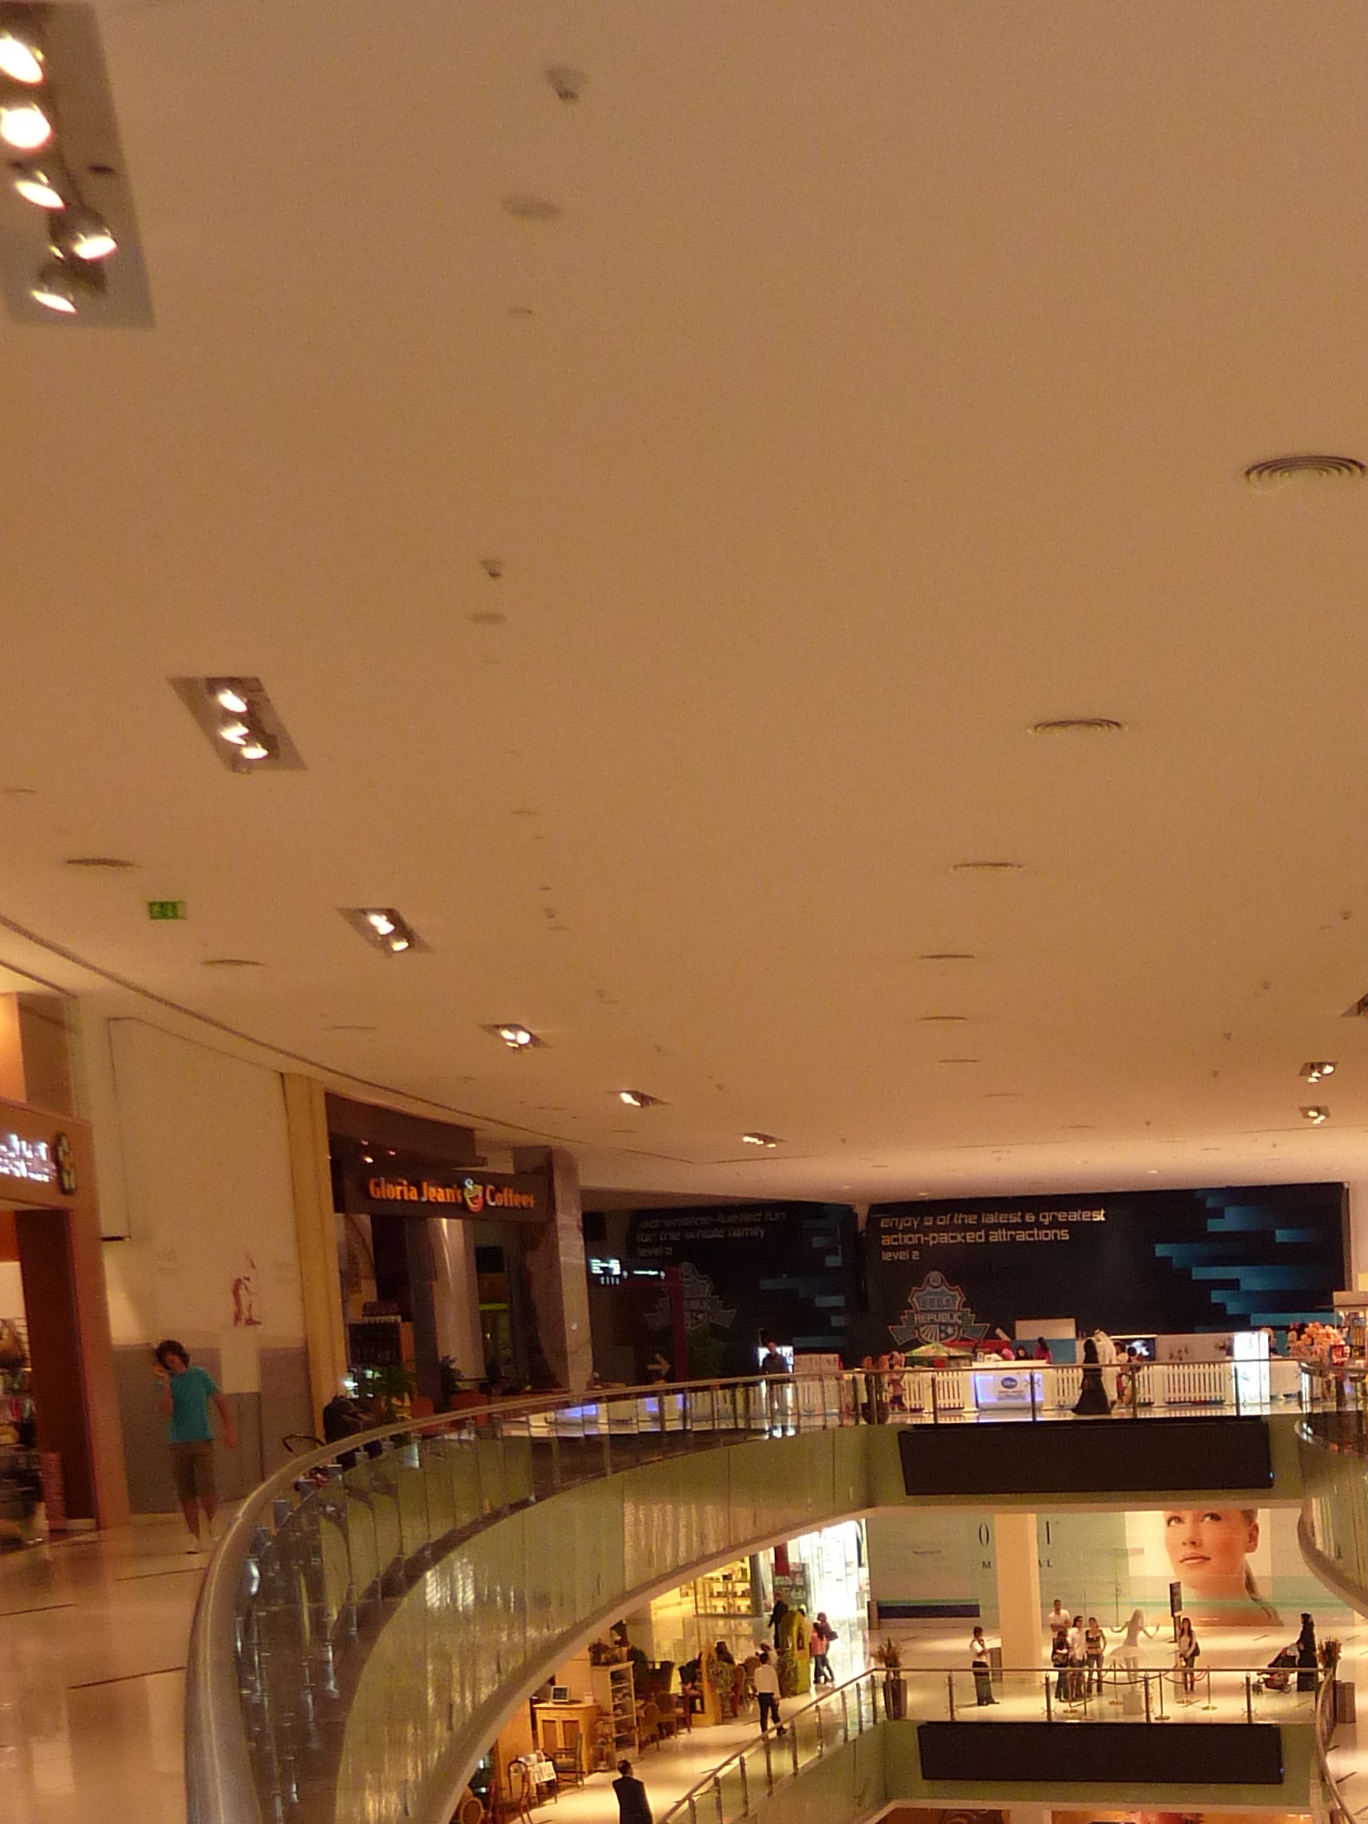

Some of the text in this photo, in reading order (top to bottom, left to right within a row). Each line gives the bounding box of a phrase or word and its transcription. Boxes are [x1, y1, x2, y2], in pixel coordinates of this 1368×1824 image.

[368, 1177, 418, 1201] Gloria
[420, 1181, 463, 1204] Jean's
[880, 1214, 921, 1230] enjoy
[936, 1214, 950, 1226] of
[954, 1212, 977, 1225] the
[981, 1211, 1022, 1225] latest
[1039, 1208, 1106, 1226] greatest
[881, 1227, 1070, 1246] action-packed attractions
[881, 1250, 920, 1261] level 2
